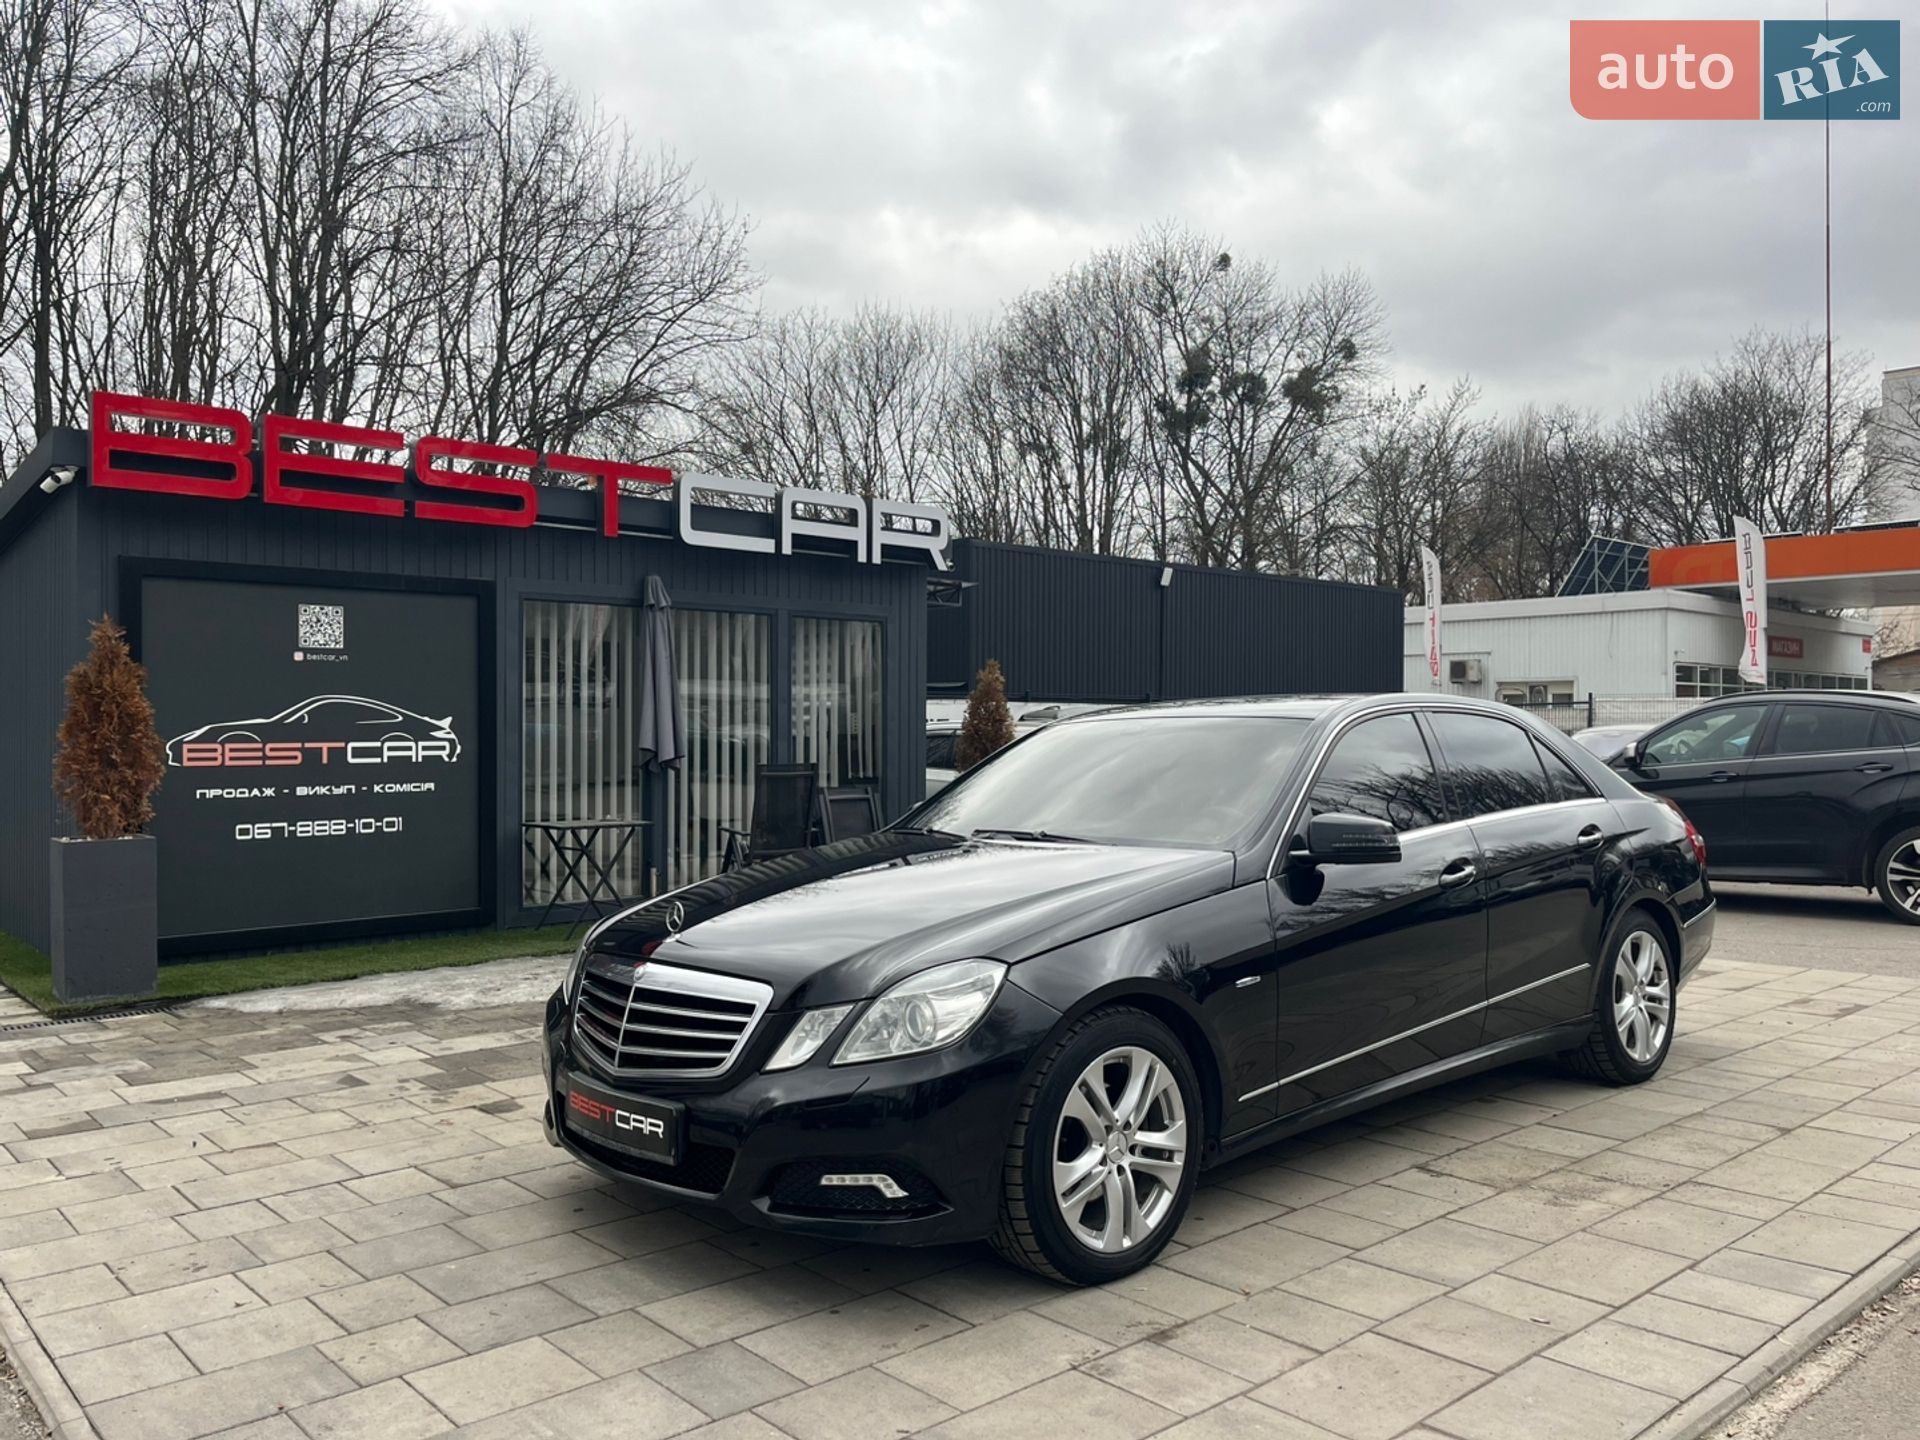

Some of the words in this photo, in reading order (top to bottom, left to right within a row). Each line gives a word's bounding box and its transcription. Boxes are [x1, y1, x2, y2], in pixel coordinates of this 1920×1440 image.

[196, 787, 276, 799] ПРОДАЖ
[296, 785, 355, 796] ВИКУП
[235, 816, 403, 840] 067-888-10-01
